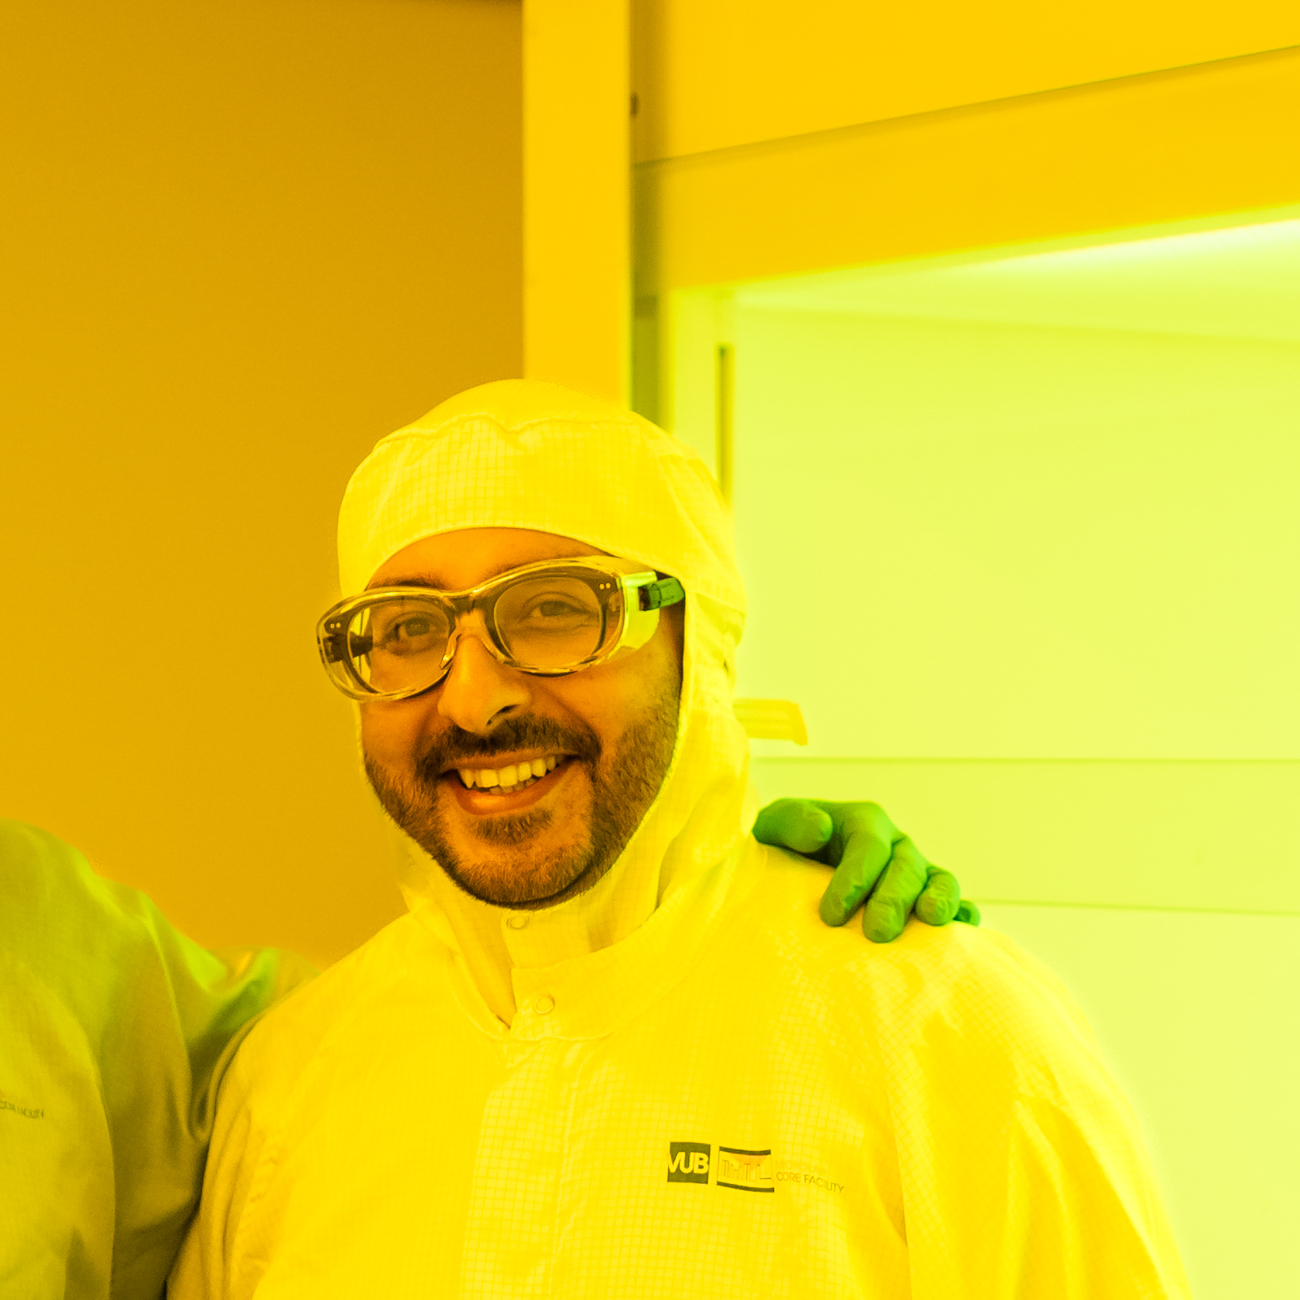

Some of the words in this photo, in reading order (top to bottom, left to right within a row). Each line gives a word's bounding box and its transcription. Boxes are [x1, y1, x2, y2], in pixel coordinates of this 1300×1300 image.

[667, 1151, 710, 1175] VUB
[776, 1171, 801, 1183] CORE
[803, 1174, 845, 1194] FACILITY
